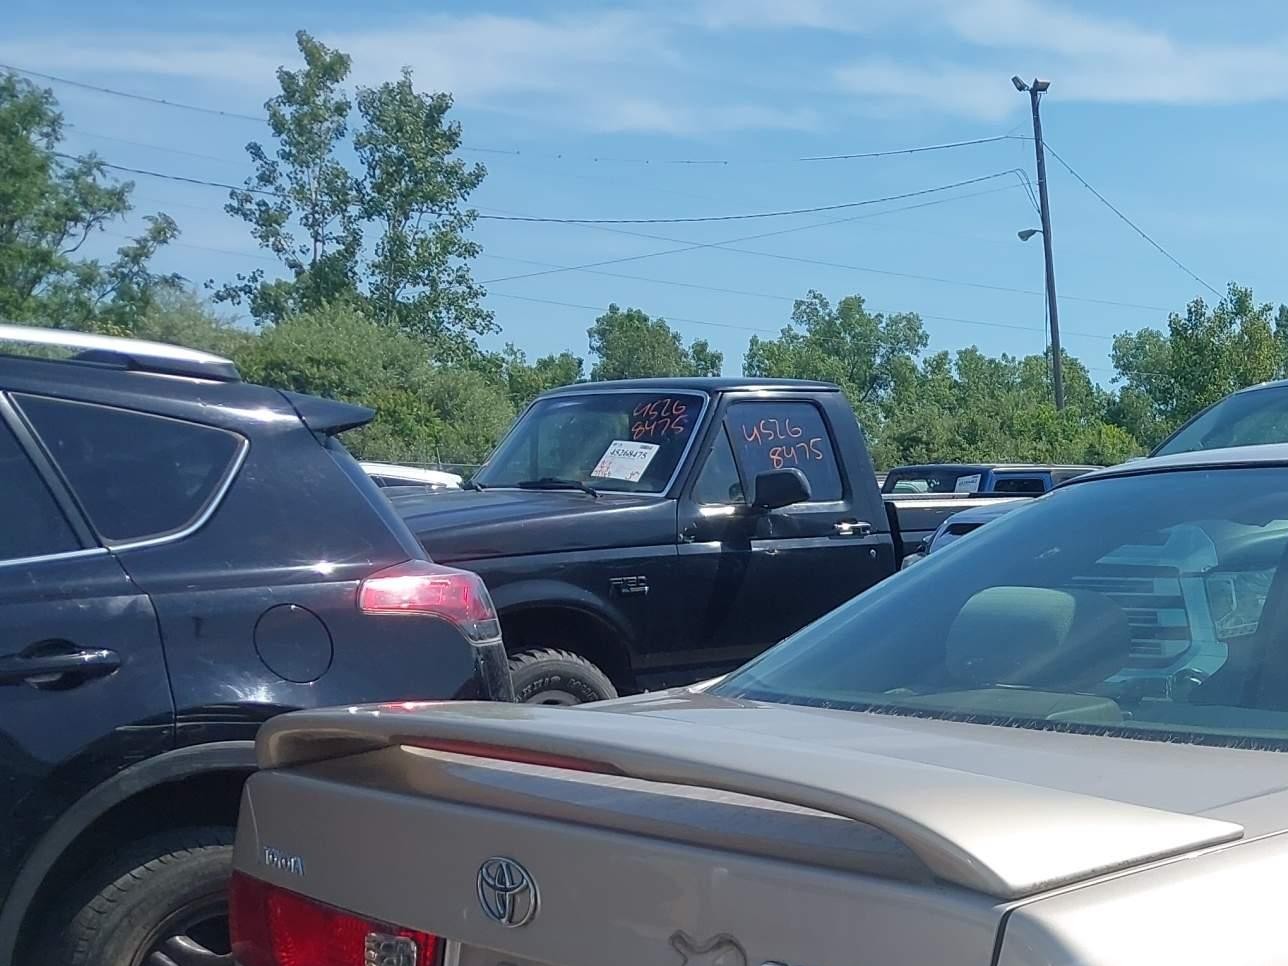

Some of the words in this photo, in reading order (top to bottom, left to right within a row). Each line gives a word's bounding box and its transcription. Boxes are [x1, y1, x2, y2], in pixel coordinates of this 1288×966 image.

[633, 399, 686, 419] 4526
[631, 415, 688, 440] 8475
[742, 418, 802, 445] 4526
[769, 437, 823, 469] 8475
